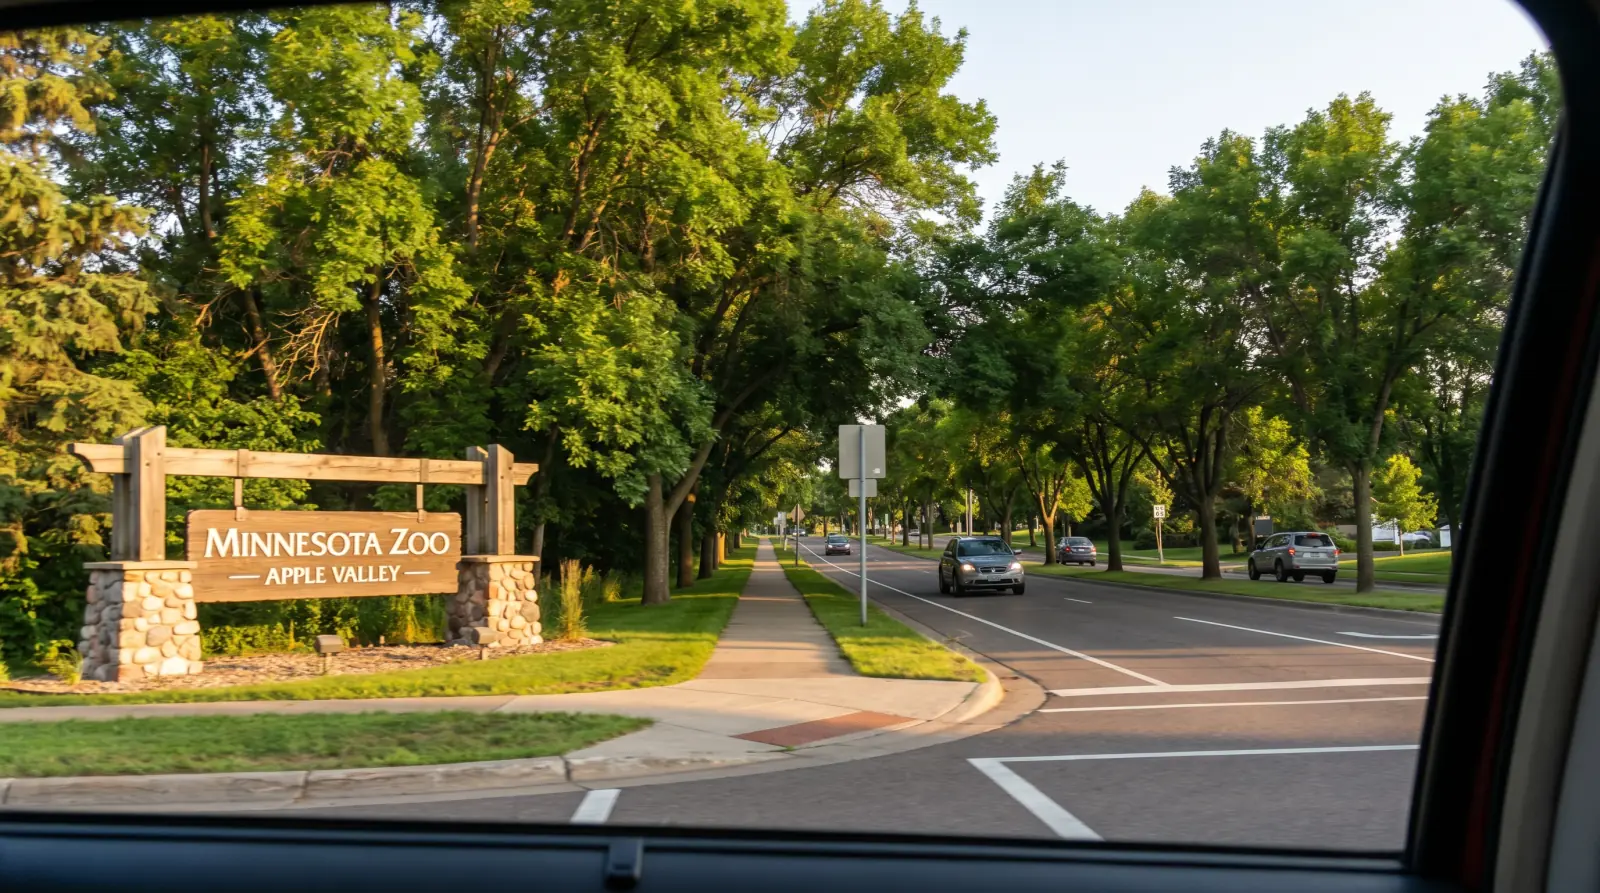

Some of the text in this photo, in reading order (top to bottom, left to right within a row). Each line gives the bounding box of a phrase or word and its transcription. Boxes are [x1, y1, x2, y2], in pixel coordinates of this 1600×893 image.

[204, 527, 450, 558] MINNESOTA ZOO
[264, 565, 401, 586] APPLE VALLEY
